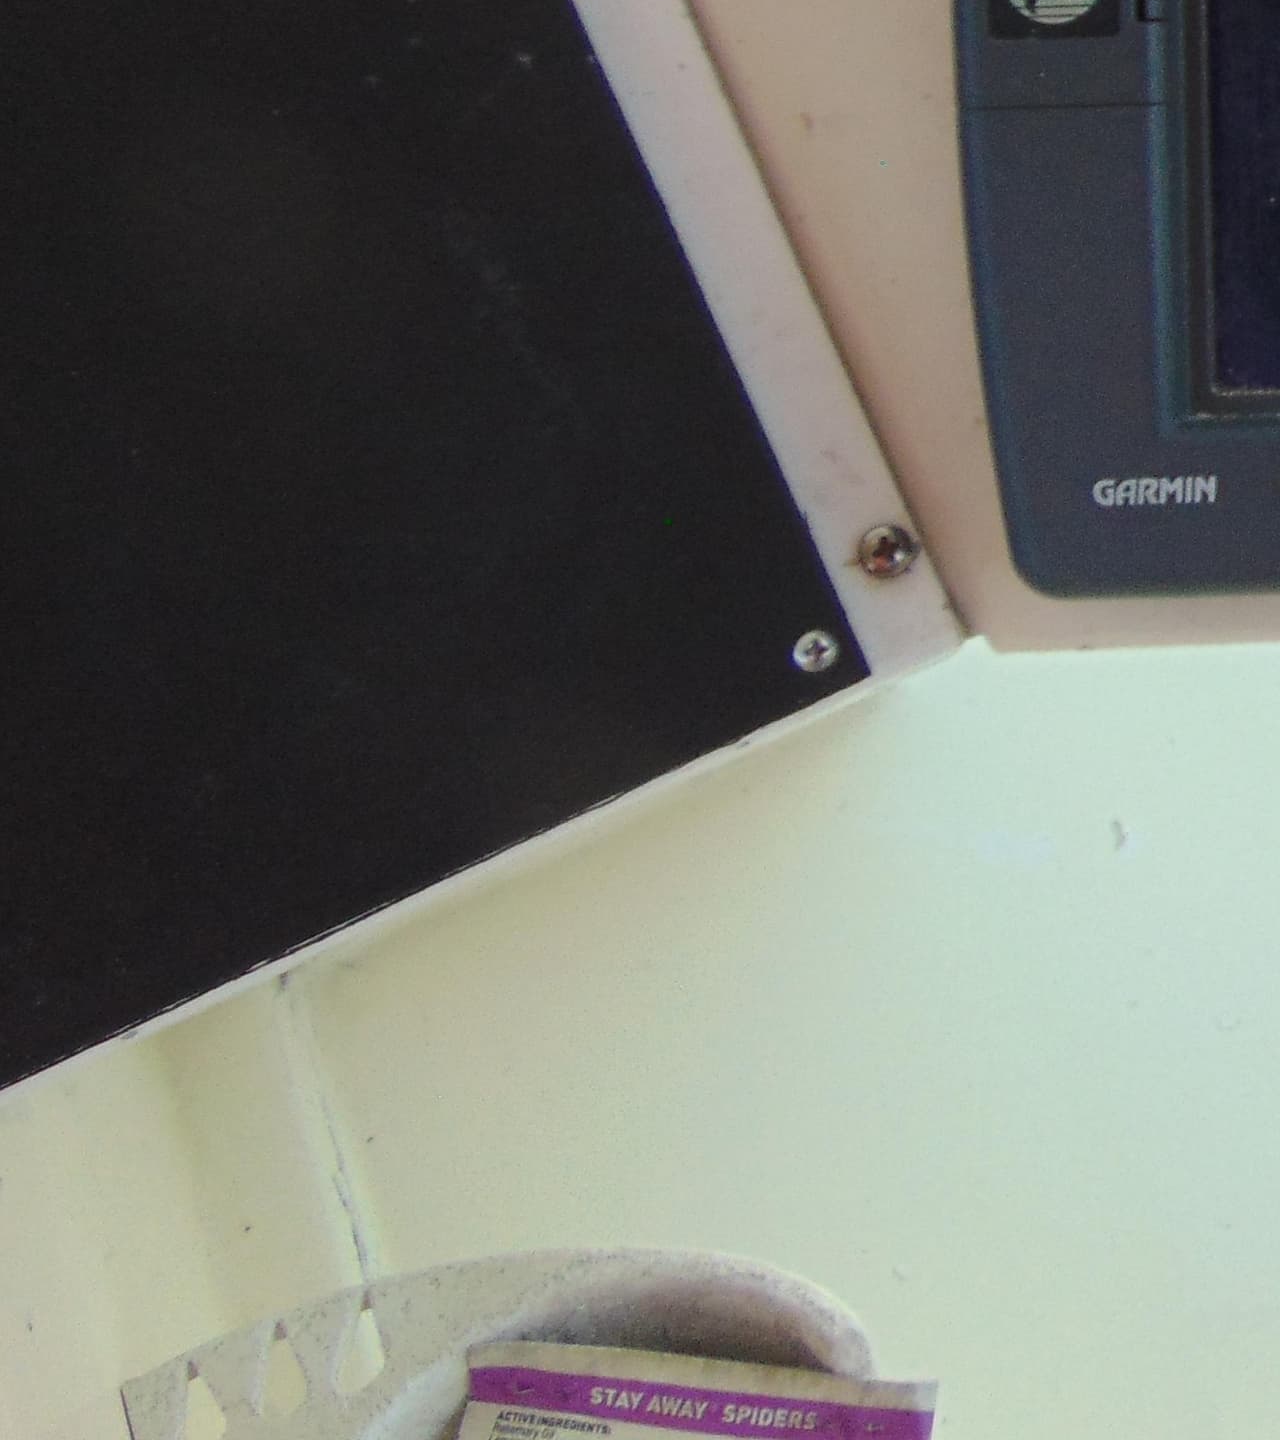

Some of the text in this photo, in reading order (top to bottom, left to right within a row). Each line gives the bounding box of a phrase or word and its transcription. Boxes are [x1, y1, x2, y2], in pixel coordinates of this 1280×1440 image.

[1092, 476, 1218, 506] GARMIN
[497, 1411, 536, 1425] ACTIVE
[590, 1387, 818, 1431] STAY AWAY SPIDERS
